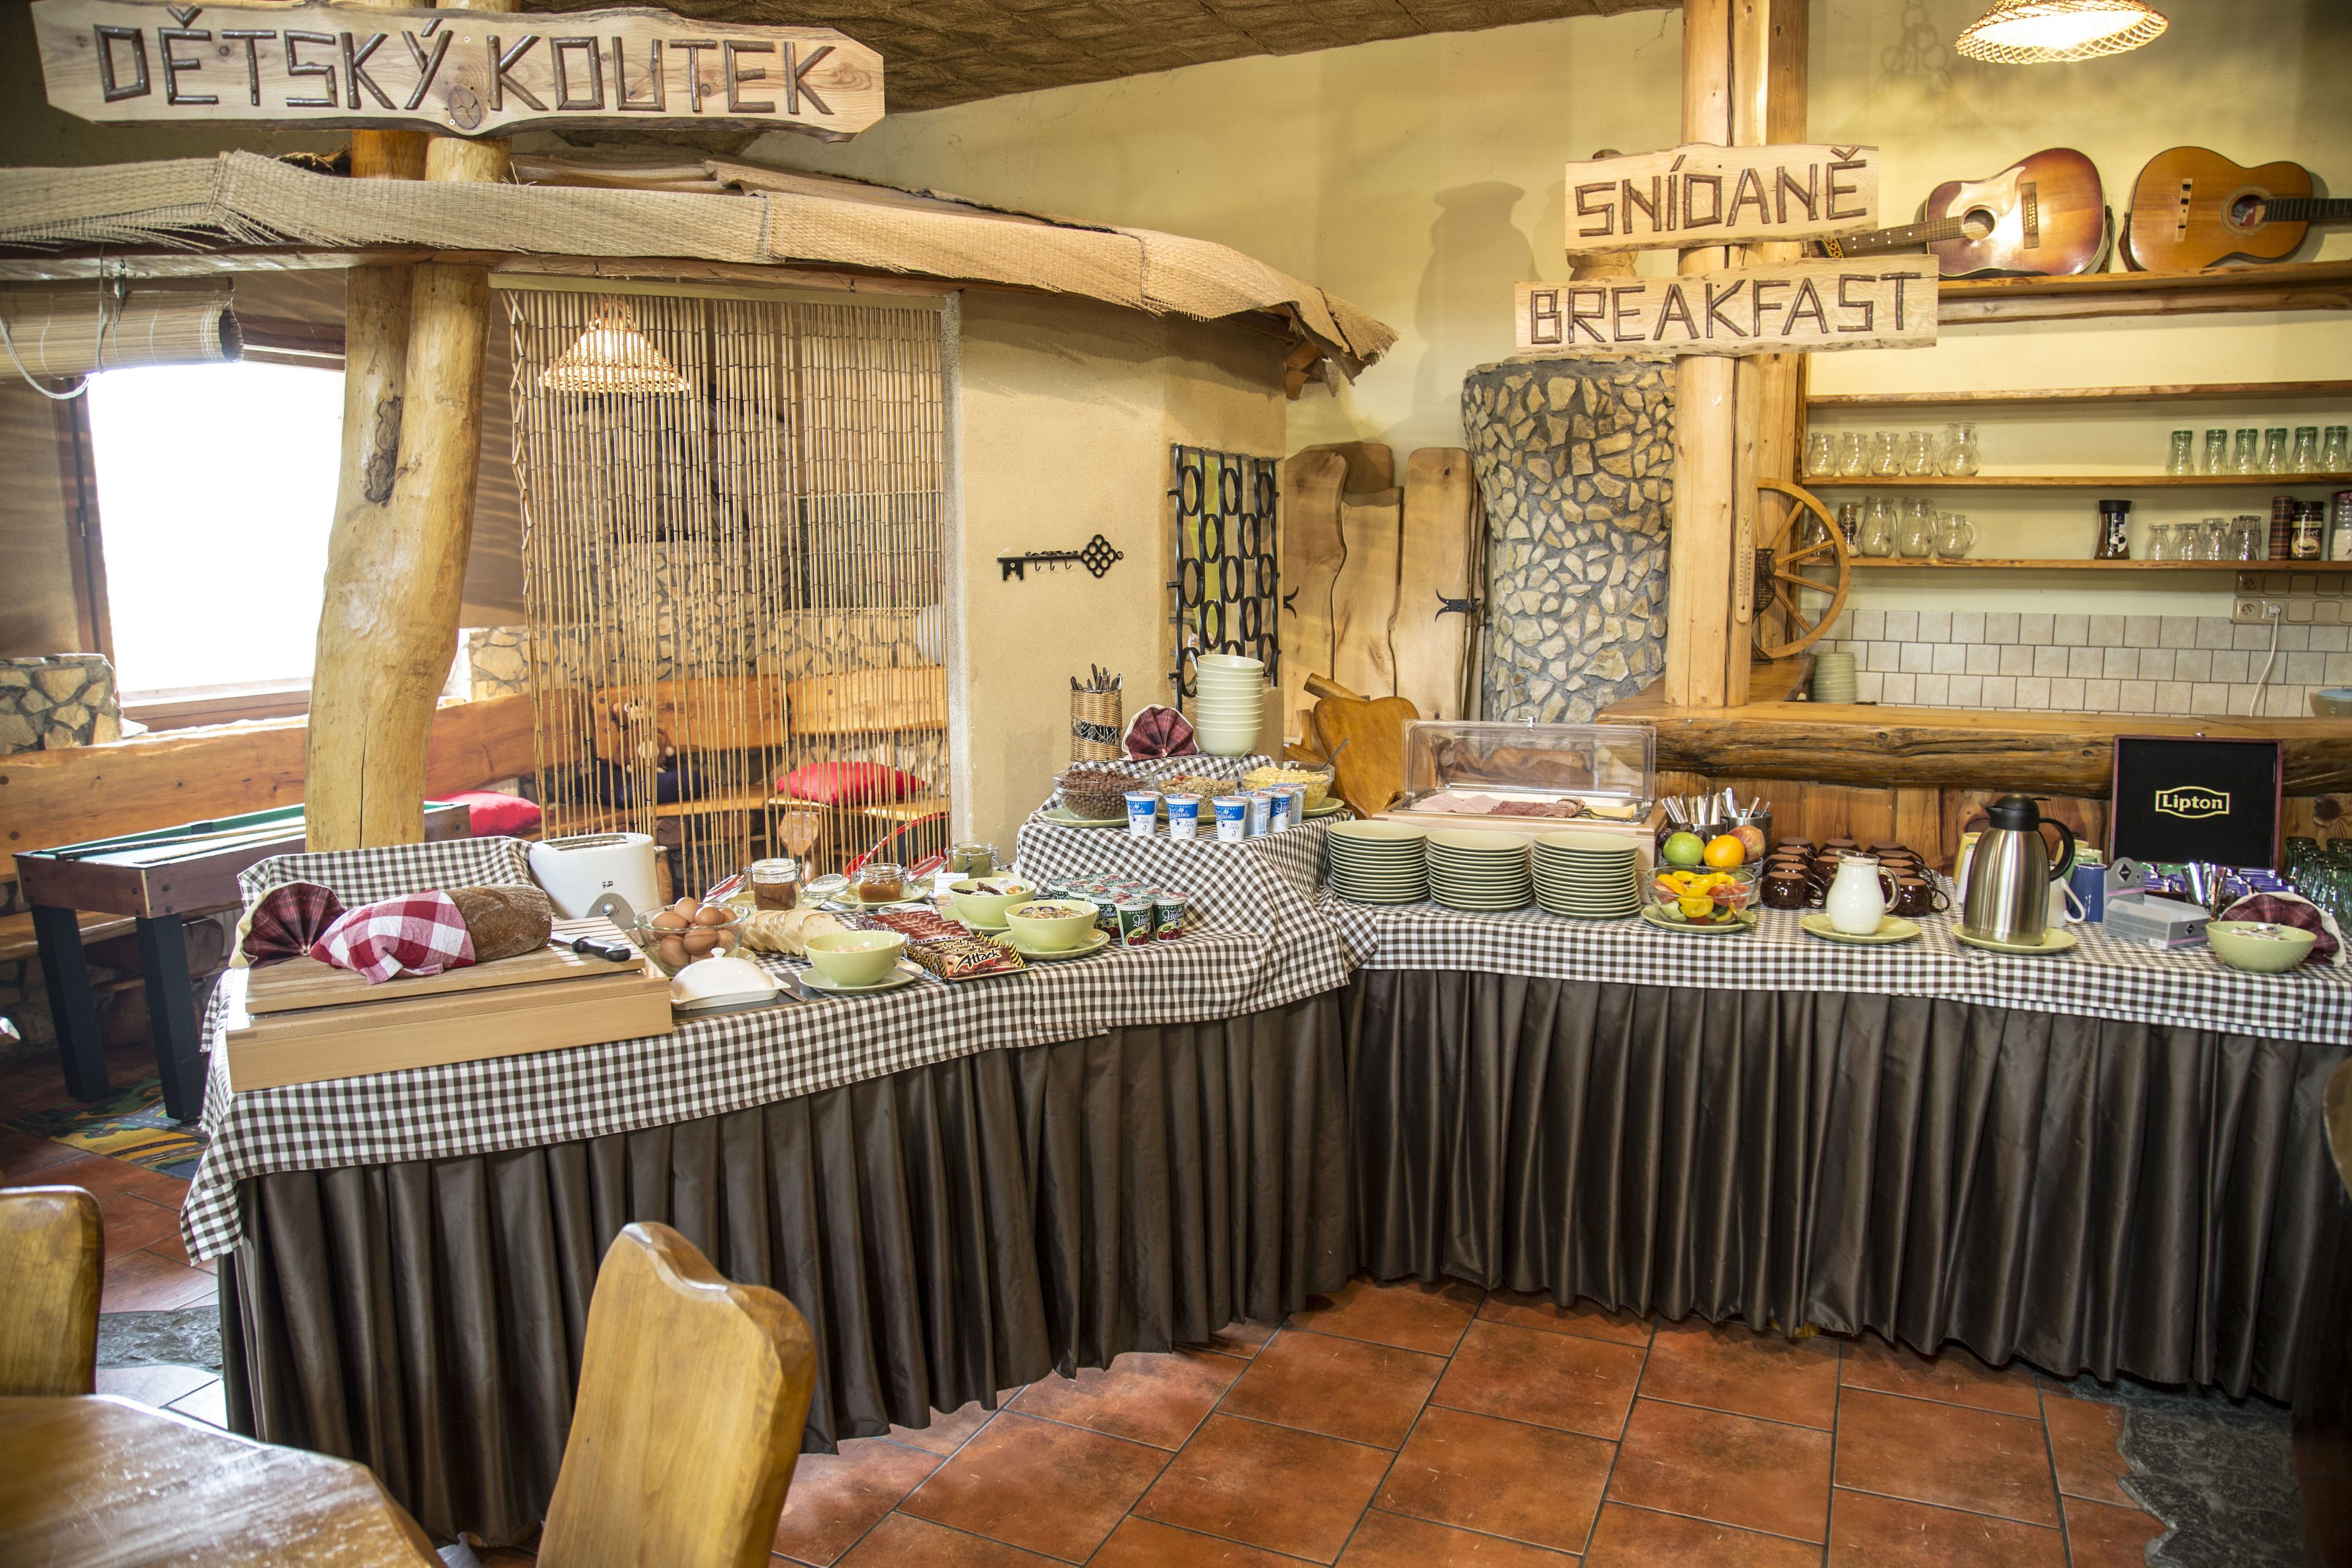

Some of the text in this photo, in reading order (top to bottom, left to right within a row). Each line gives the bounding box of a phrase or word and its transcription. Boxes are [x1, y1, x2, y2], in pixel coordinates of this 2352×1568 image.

[93, 4, 837, 115] DĚTSKÝ KOUTEK
[1575, 146, 1867, 237] SNÍDANĚ
[1531, 271, 1921, 345] BREAKFAST
[2163, 794, 2223, 812] Lipton
[954, 949, 1001, 971] Attack
